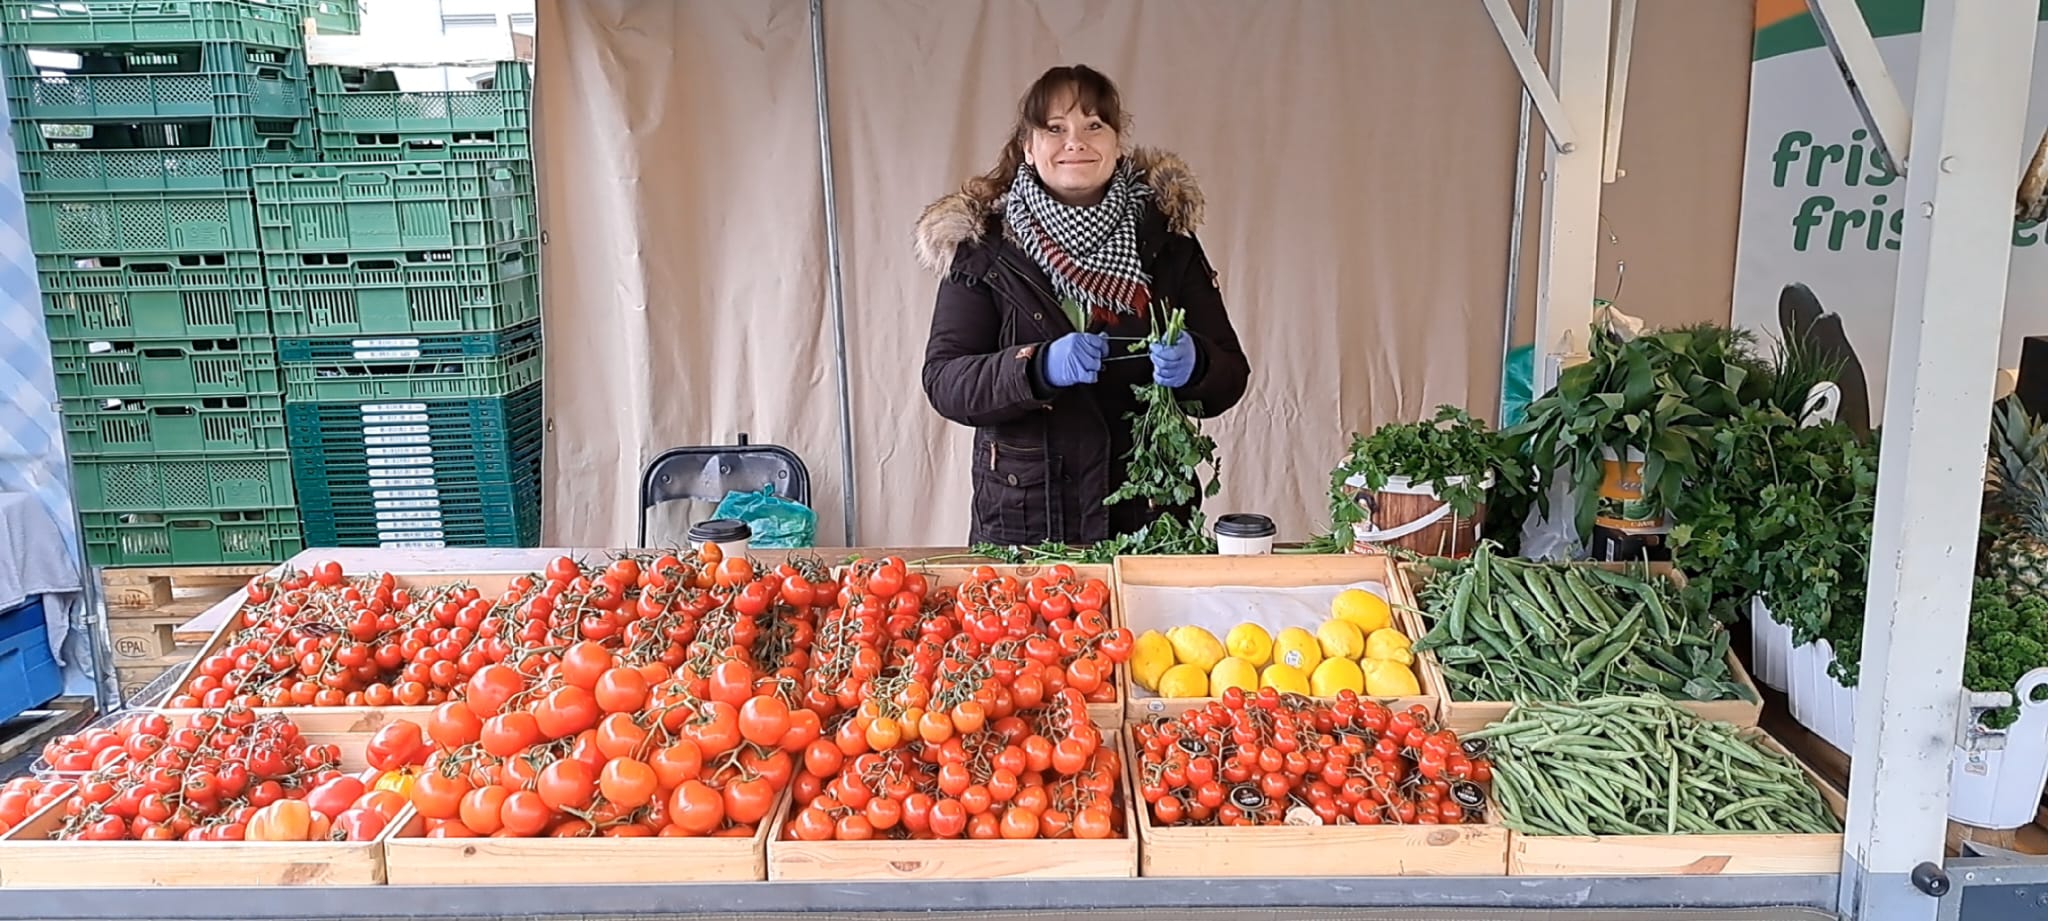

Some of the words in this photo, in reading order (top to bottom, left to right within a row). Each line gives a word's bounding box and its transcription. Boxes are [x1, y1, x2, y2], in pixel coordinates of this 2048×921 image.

[1772, 129, 1898, 187] fris
[1792, 194, 1904, 251] fris
[120, 641, 146, 654] EPAL
